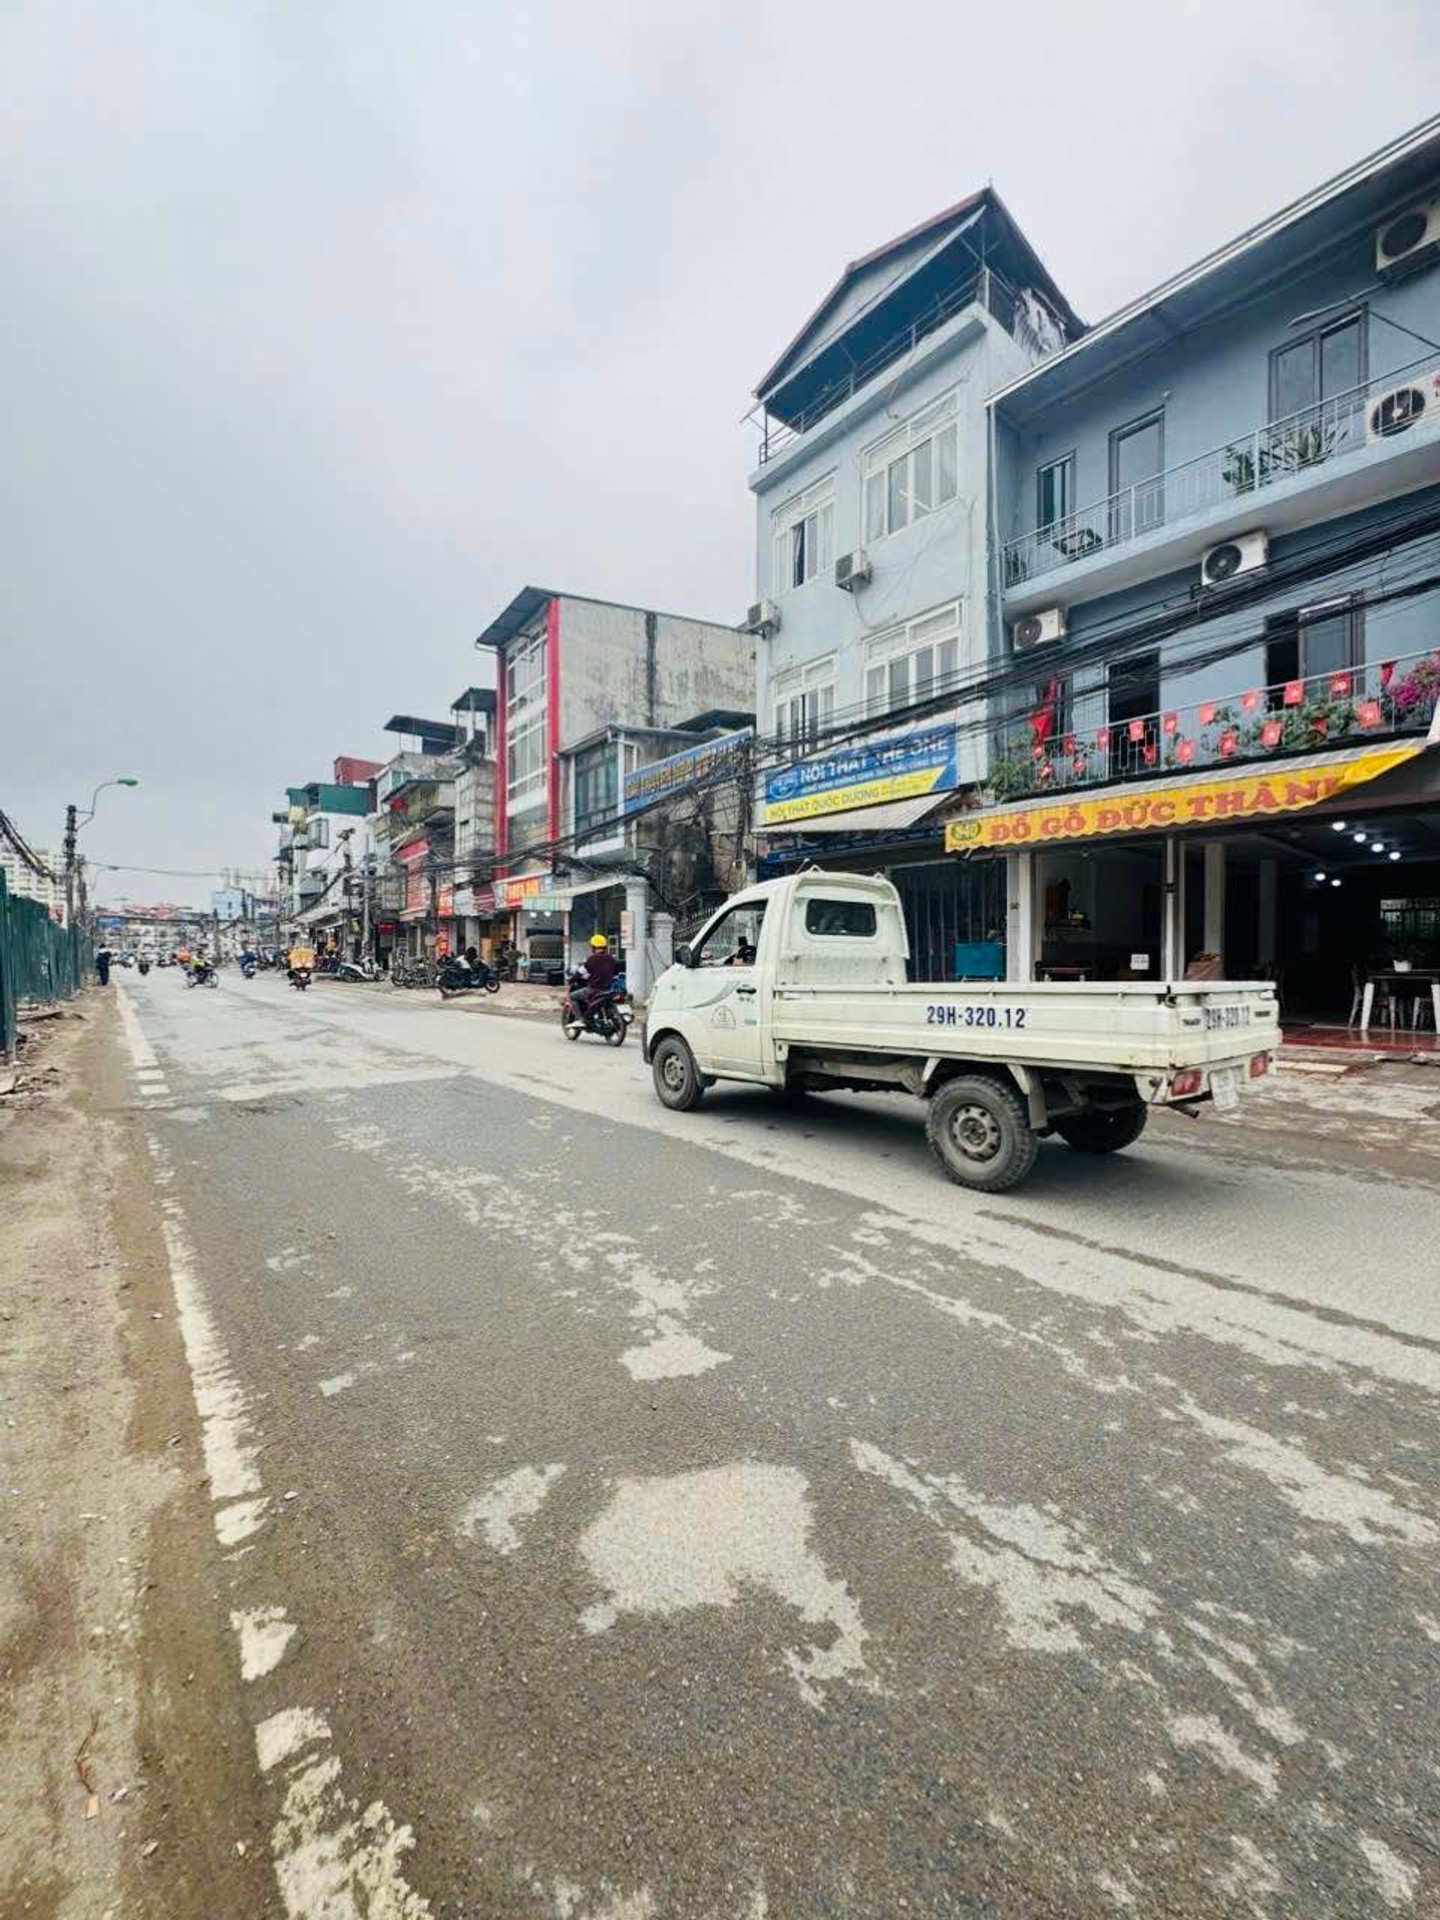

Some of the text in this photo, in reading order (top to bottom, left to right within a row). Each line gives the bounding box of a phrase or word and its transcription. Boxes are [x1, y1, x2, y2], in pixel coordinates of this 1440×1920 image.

[988, 810, 1031, 842] ĐỒ
[1041, 803, 1087, 836] GỖ
[1098, 798, 1177, 829] ĐỨC
[927, 1005, 1026, 1029] 29H-320.12
